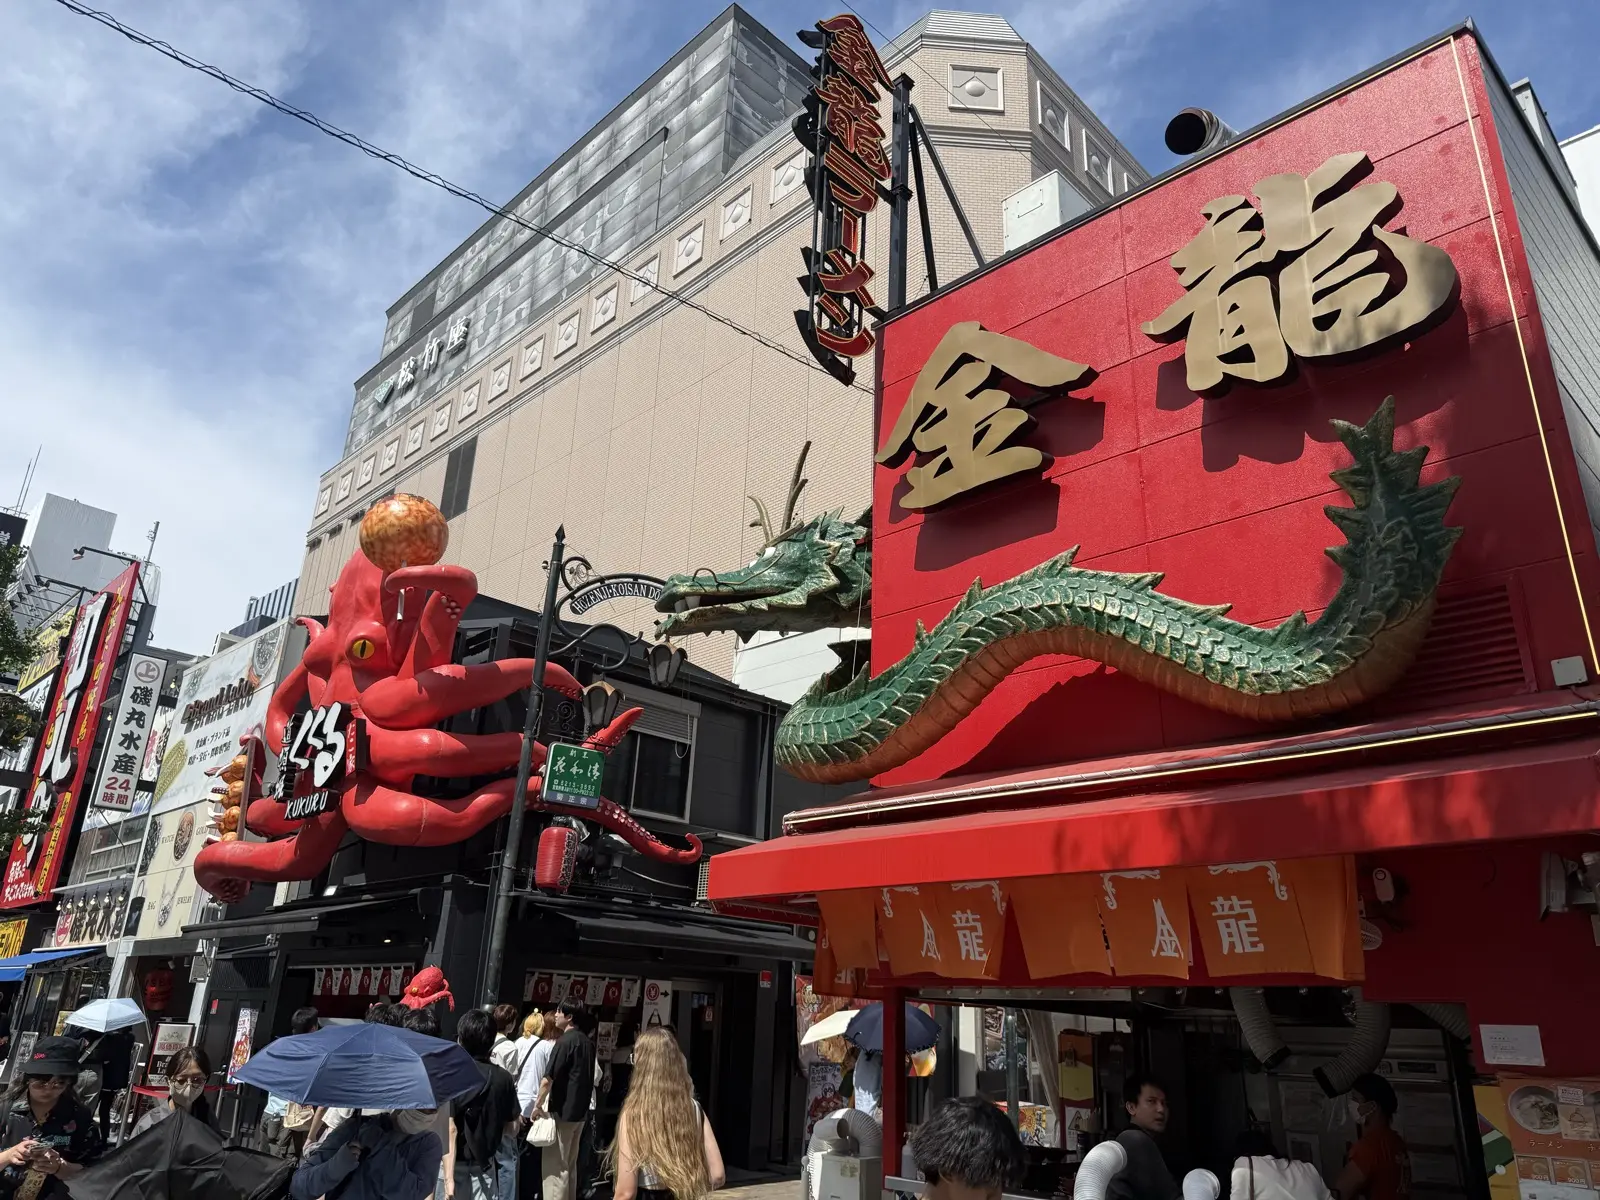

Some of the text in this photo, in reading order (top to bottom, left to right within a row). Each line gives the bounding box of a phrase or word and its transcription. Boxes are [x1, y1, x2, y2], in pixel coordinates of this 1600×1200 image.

[875, 151, 1459, 509] 金龍
[648, 586, 661, 600] DŌ
[111, 686, 154, 776] 磯丸水産
[105, 776, 131, 792] 24
[102, 792, 129, 806] 時間
[284, 791, 328, 820] KUKURU
[1529, 1139, 1564, 1149] ラーメン
[1567, 1177, 1586, 1186] 900円
